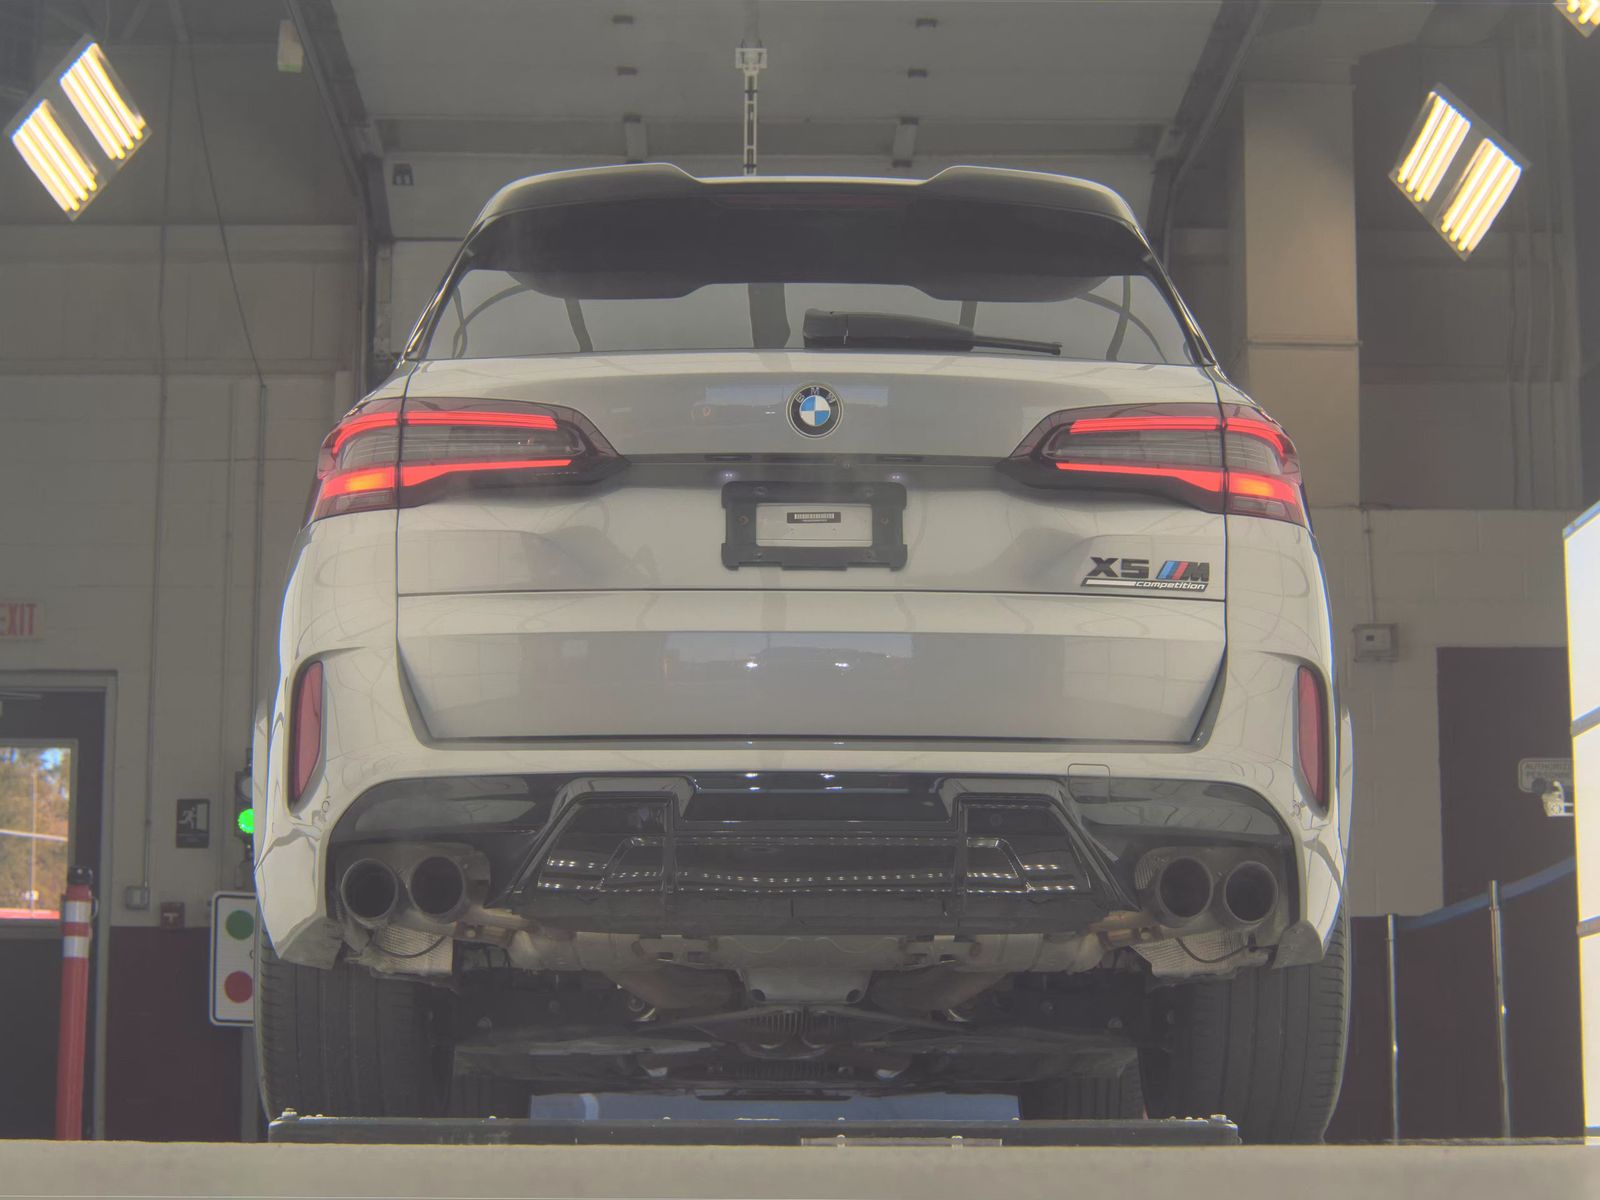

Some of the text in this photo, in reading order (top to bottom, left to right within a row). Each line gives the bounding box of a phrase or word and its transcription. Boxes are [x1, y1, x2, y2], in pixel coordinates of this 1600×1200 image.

[795, 387, 836, 403] BMW
[1086, 556, 1150, 579] X5
[1136, 581, 1205, 590] competition
